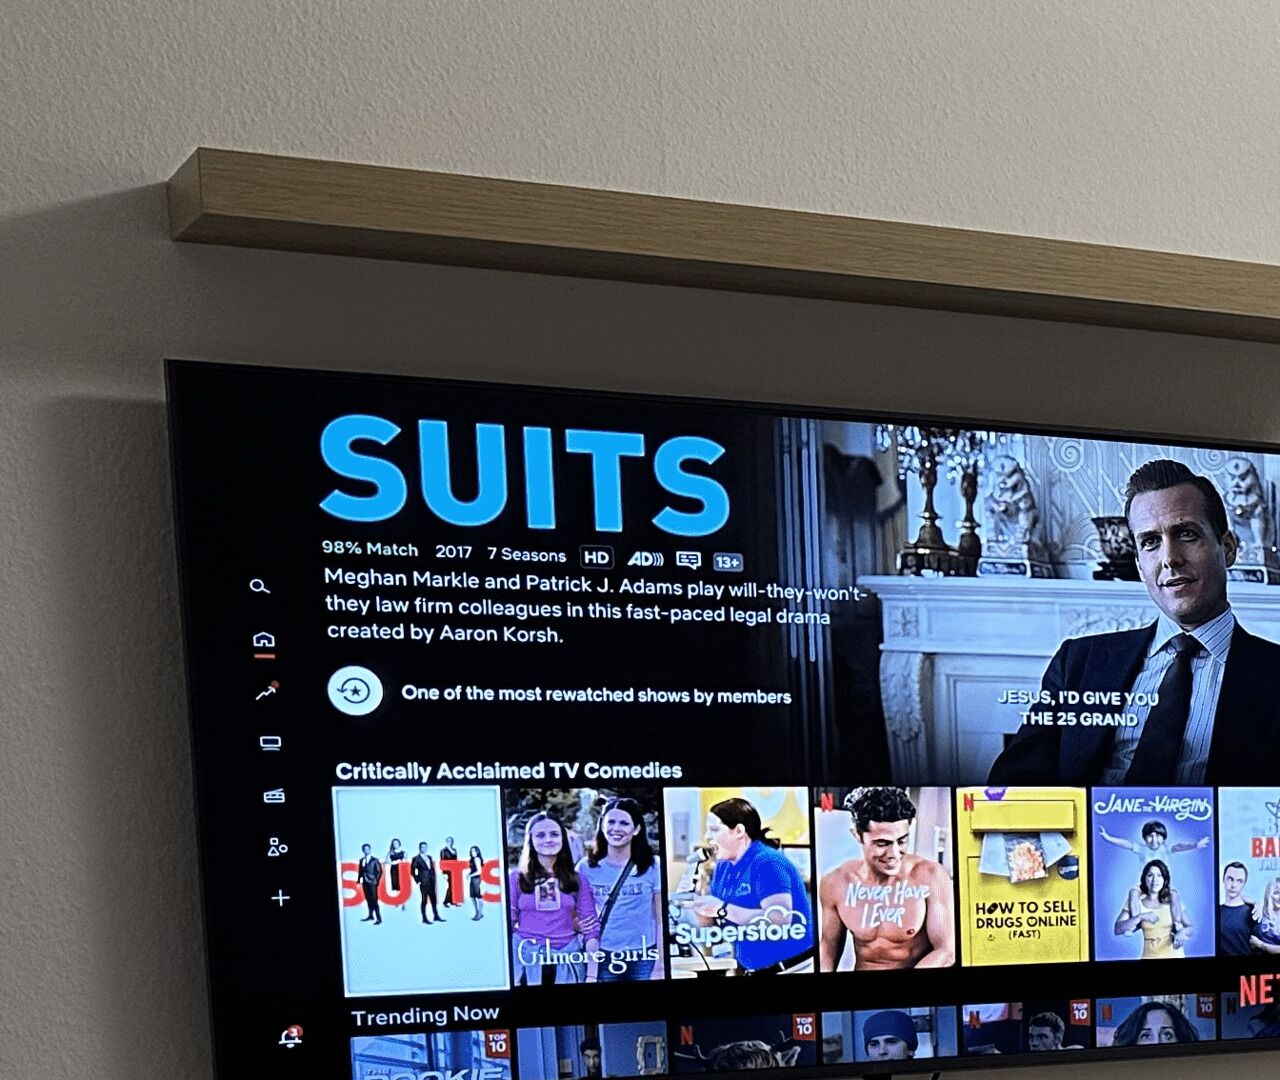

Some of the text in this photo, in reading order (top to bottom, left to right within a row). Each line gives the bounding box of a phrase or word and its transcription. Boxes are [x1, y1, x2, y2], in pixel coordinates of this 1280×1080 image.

[319, 413, 730, 537] SUITS
[322, 540, 362, 555] 98%
[366, 542, 419, 557] Match
[435, 545, 473, 559] 2017
[487, 547, 497, 560] 7
[501, 547, 567, 563] Seasons
[584, 551, 610, 565] HD
[715, 556, 740, 569] 13+
[324, 567, 868, 604] Meghan Markle and Patrick J. Adams play will-they-won't-
[325, 594, 831, 627] they law firm colleagues in this fast-paced legal drama
[327, 623, 565, 644] created by Aaron Korsh.
[401, 684, 792, 708] One of the most rewatched shows by members
[998, 689, 1160, 706] JESUS, I'D GIVE YOU
[1019, 711, 1139, 727] THE 25 GRAND
[335, 762, 683, 783] Critically Acclaimed TV Comedies
[1094, 794, 1145, 814] JANE
[1149, 796, 1212, 821] VIRGIN
[846, 880, 930, 907] Never Have
[861, 905, 905, 928] I Ever
[975, 900, 1077, 915] HOW TO SELL
[674, 919, 807, 946] Superstore
[976, 915, 1077, 930] DRUGS ONLINE
[1008, 929, 1041, 940] (FAST)
[518, 938, 660, 975] Gilmore girls
[351, 1005, 500, 1026] Trending Now
[1071, 1002, 1088, 1010] TOP
[1072, 1010, 1088, 1020] 10
[1200, 1003, 1213, 1013] 10
[796, 1017, 813, 1025] TOP
[796, 1024, 813, 1035] 10
[488, 1033, 507, 1041] TOP
[489, 1042, 507, 1053] 10
